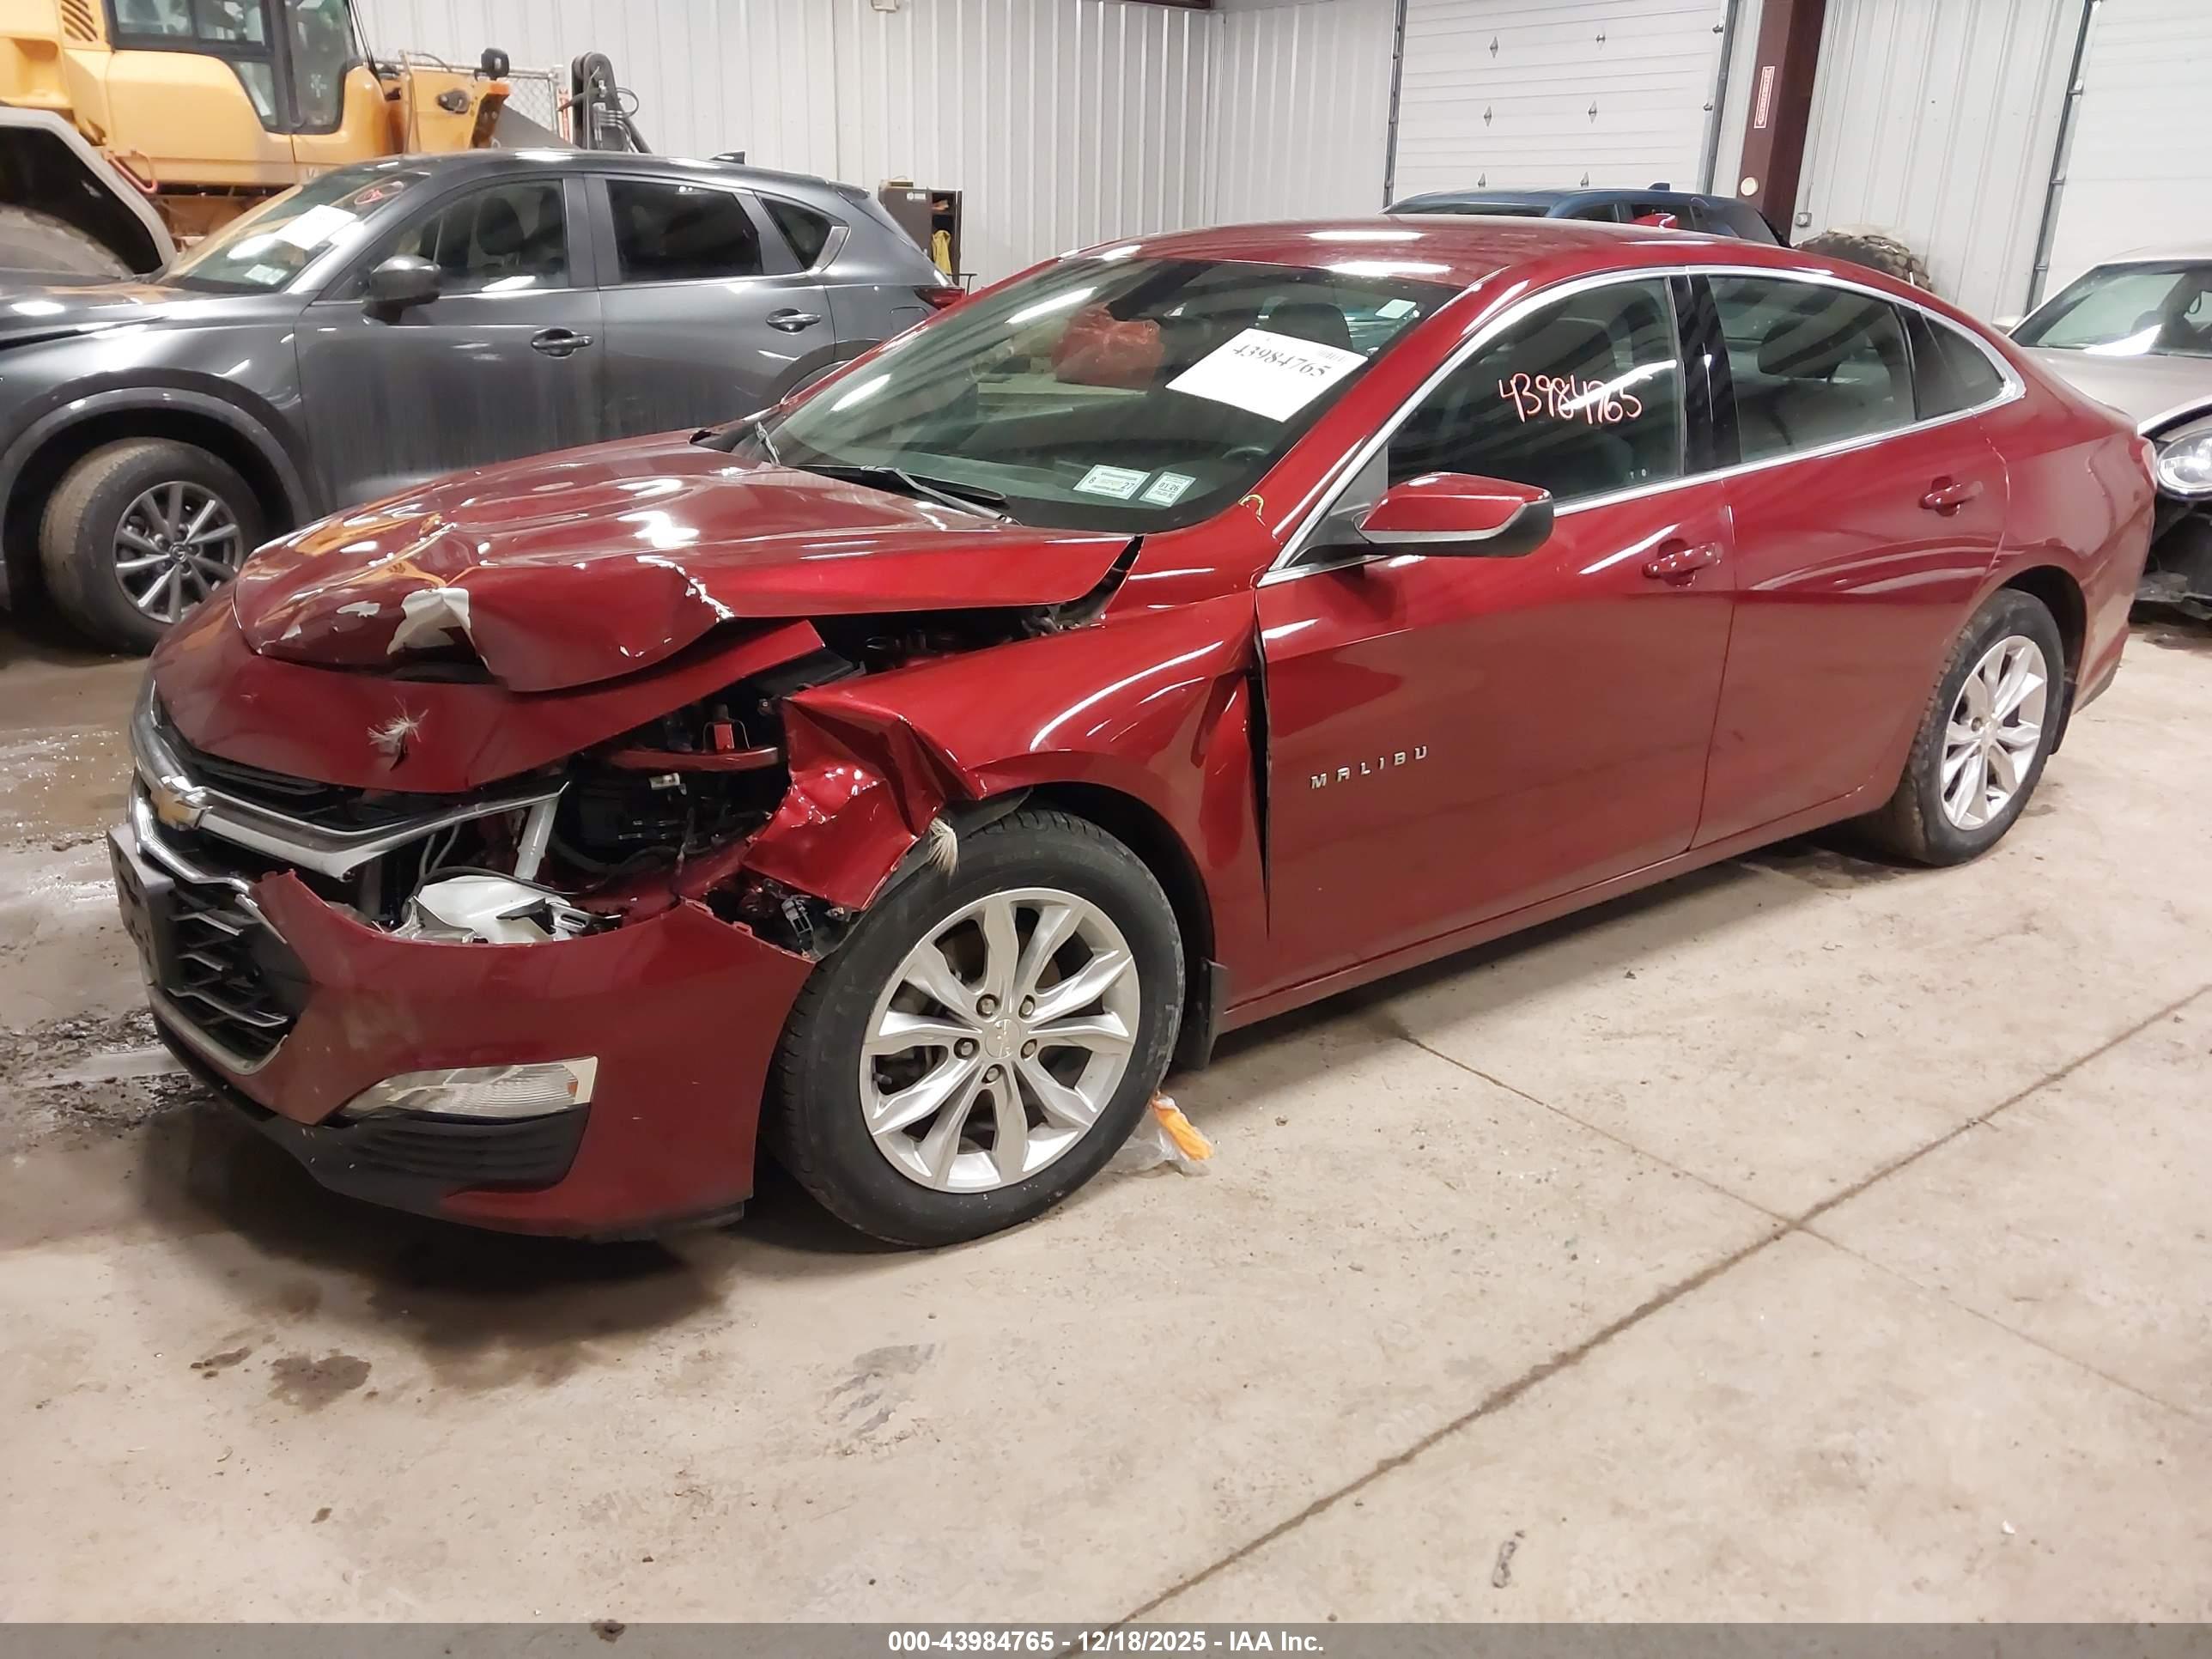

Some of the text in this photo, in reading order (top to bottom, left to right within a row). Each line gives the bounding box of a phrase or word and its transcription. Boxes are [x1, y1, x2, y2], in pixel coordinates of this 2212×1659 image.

[1232, 344, 1332, 376] 43984765
[1498, 373, 1643, 425] 43984765
[1120, 481, 1135, 491] 27
[1310, 745, 1427, 789] MALIBU
